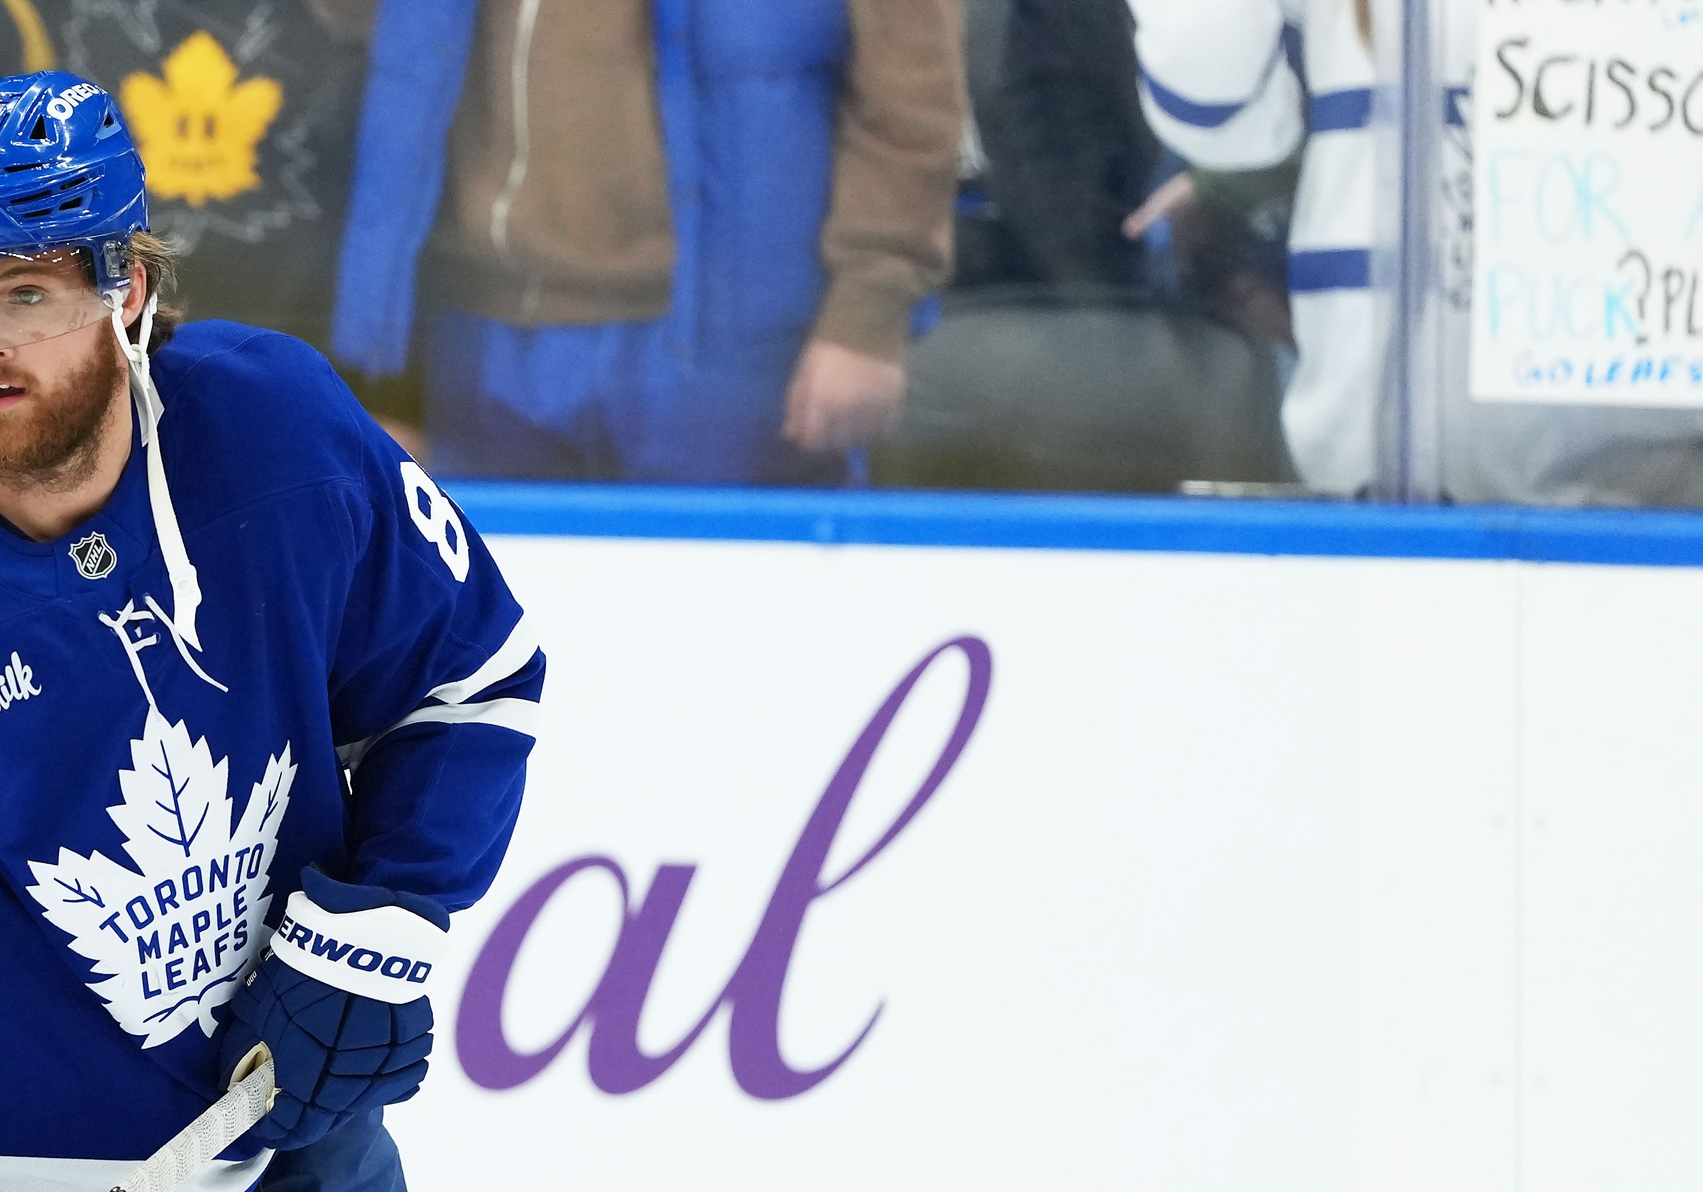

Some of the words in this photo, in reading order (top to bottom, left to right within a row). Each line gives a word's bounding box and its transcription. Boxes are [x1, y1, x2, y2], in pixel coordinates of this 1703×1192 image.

[46, 82, 100, 122] OREO
[1488, 150, 1633, 244] FOR
[86, 544, 103, 573] NHL
[400, 461, 470, 583] 8
[99, 842, 265, 944] TORONTO
[136, 884, 248, 965] MAPLE
[140, 920, 248, 1000] LEAFS
